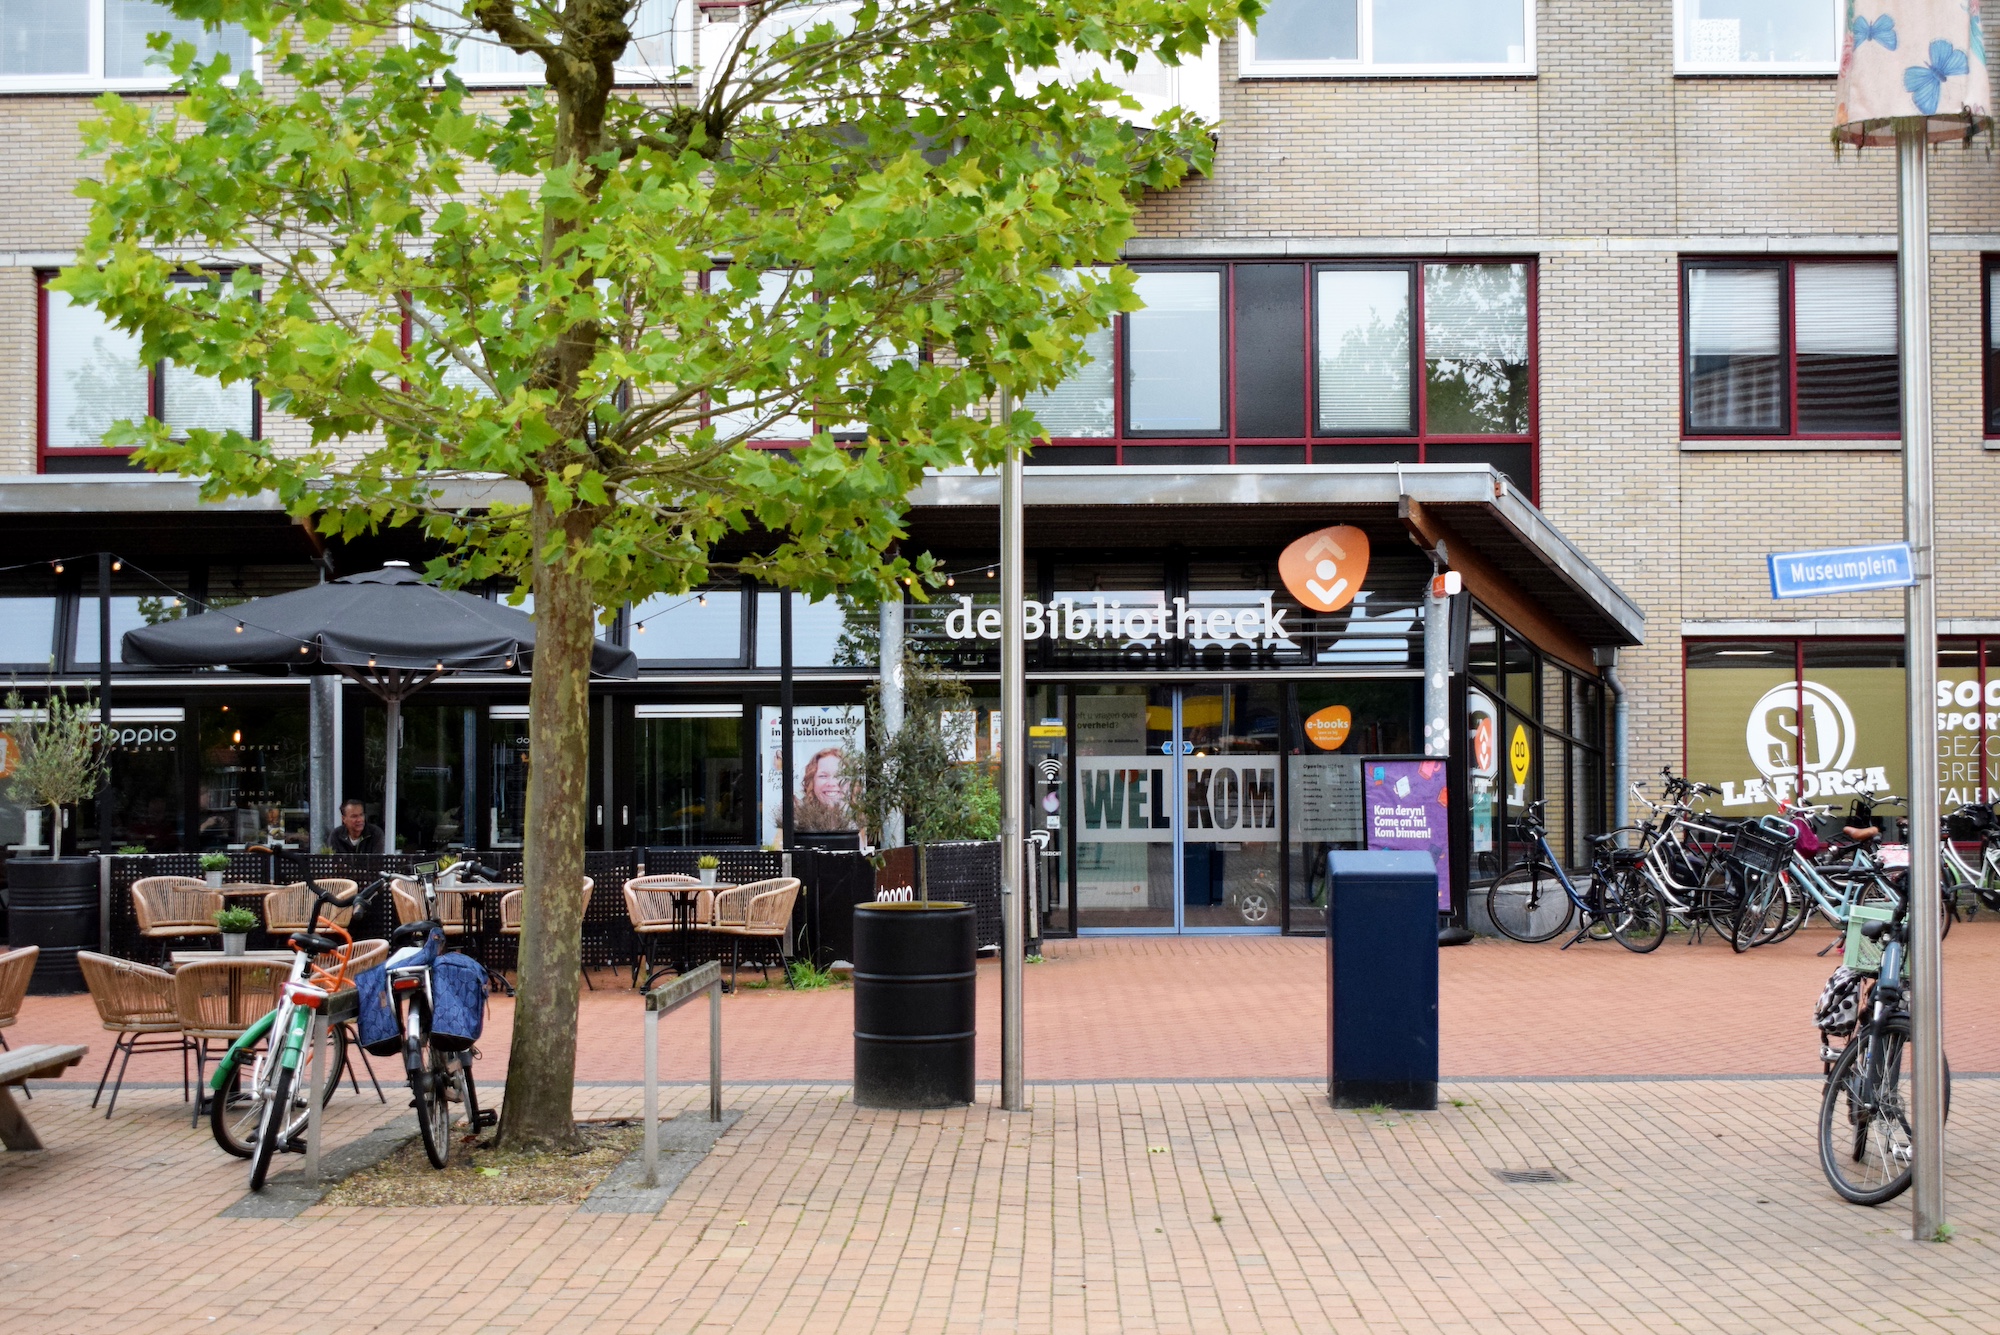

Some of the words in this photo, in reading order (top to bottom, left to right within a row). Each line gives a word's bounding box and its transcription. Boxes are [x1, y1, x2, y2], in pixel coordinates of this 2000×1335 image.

[1790, 555, 1897, 583] Museumplein
[945, 596, 1001, 640] de
[1022, 596, 1290, 640] Bibliotheek
[801, 716, 816, 726] wij
[817, 716, 833, 726] jou
[835, 716, 856, 725] snel
[1306, 718, 1349, 729] e-books
[1938, 712, 2000, 731] SPOR
[771, 728, 781, 736] in
[797, 727, 858, 736] bibliotheek?
[229, 765, 267, 773] THEE
[1774, 766, 1890, 802] FORSA
[1374, 805, 1394, 815] Kom
[1395, 804, 1425, 818] deryn!
[1374, 816, 1399, 827] Come
[1400, 818, 1412, 827] on
[1412, 816, 1427, 827] in!
[1374, 827, 1395, 838] Kom
[1395, 826, 1431, 839] binnen!
